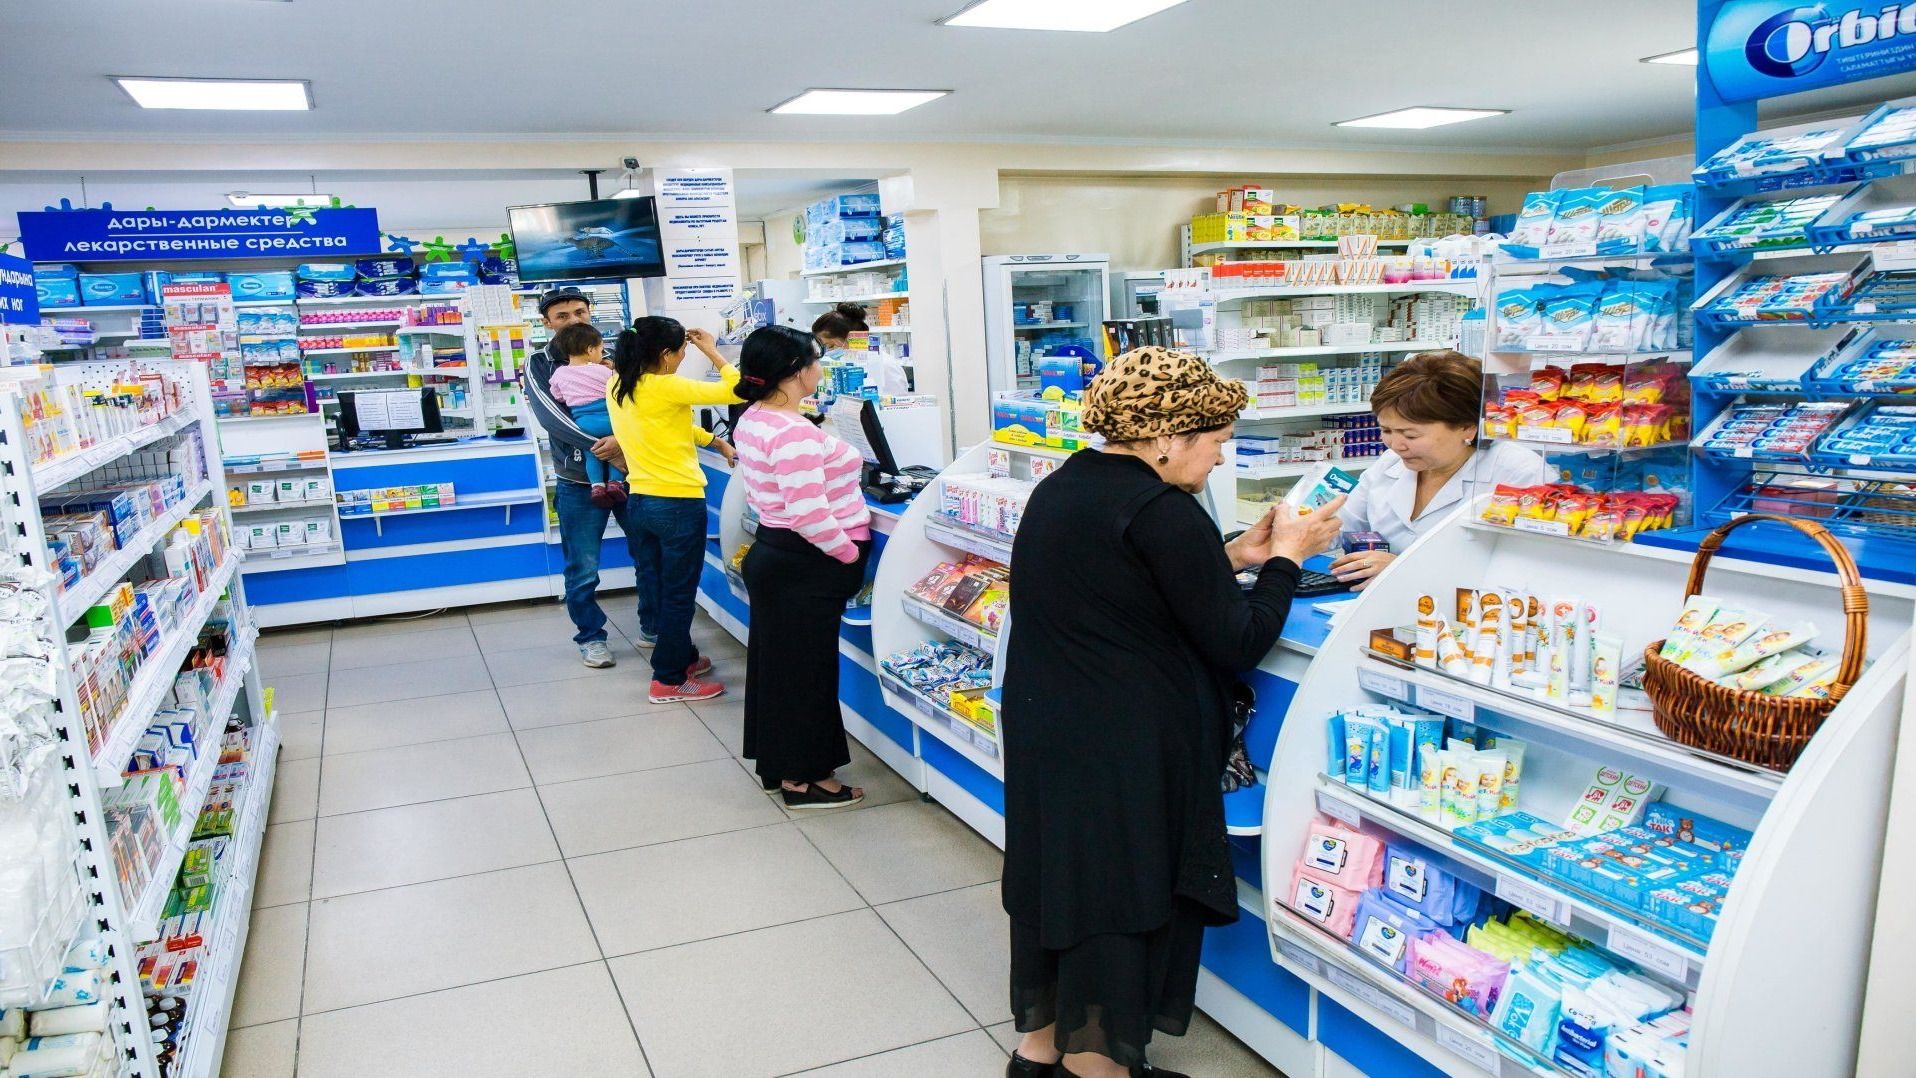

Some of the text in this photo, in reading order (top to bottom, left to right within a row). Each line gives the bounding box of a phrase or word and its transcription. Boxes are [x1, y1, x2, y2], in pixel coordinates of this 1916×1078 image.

[107, 214, 296, 231] дары-дармектер
[64, 236, 347, 253] лекарственные средства
[163, 284, 216, 293] masculan
[11, 297, 23, 311] ног
